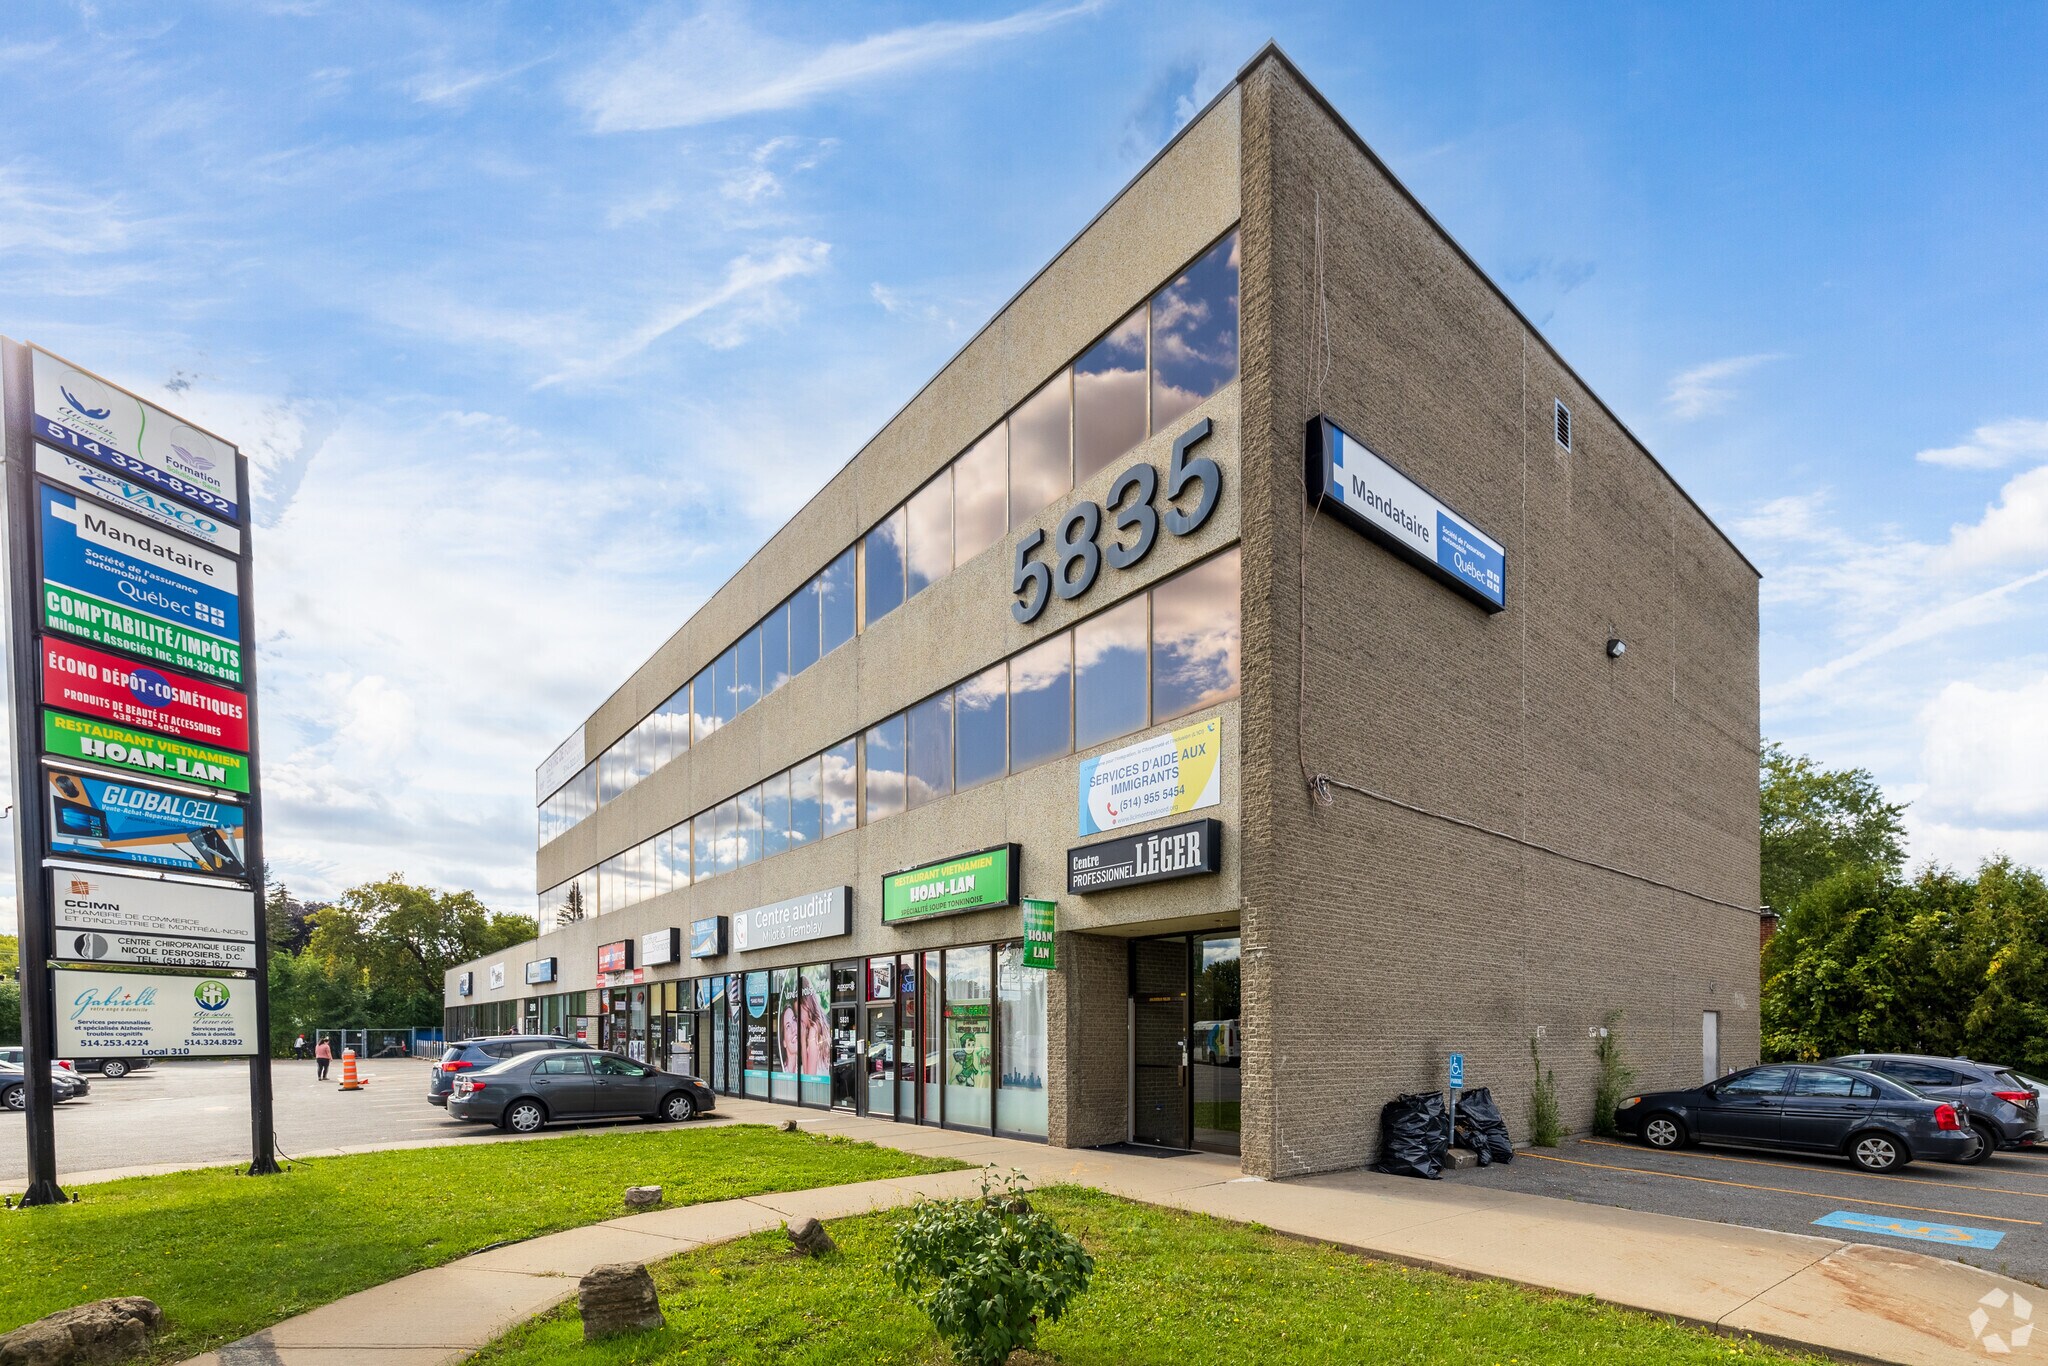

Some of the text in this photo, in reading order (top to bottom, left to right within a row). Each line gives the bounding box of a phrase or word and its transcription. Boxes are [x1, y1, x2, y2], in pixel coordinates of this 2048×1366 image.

[47, 421, 229, 513] 514 324-8292
[165, 456, 221, 488] Formation
[166, 465, 199, 485] Solutions
[121, 482, 218, 534] VASCO
[1010, 416, 1223, 625] 5835
[1352, 474, 1430, 543] Mandataire
[84, 513, 215, 577] Mandataire
[84, 548, 199, 595] Société de l'assurance
[85, 558, 148, 585] automobile
[1454, 552, 1486, 585] Québec
[118, 580, 191, 617] Québec
[46, 591, 240, 668] COMPTABILITÉ/IMPÔTS
[48, 615, 240, 682] Milone & Associés Inc. 514-326-8181
[48, 651, 97, 680] ÉCONO
[64, 688, 221, 737] PRODUITS DE BEAUTÉ ET ACCESSOIRES
[113, 711, 181, 735] 438-289-4054
[54, 717, 240, 768] RESTAURANT VIETNAMIEN
[80, 736, 227, 784] HOAN-LAN
[1089, 743, 1207, 788] SERVICES D'AIDE AUX
[1111, 767, 1180, 795] IMMIGRANTS
[1119, 784, 1186, 813] (514) 955 5454
[894, 856, 993, 888] RESTAURANT VIETNAMIEN
[1073, 831, 1202, 888] PROFESSIONNEL LÉGER
[1073, 854, 1100, 871] Centre
[909, 874, 976, 903] HOAN-LAN
[64, 900, 120, 911] CCIMN
[64, 908, 121, 919] CHAMBRE
[142, 915, 200, 925] COMMERCE
[756, 892, 833, 928] Centre auditif
[901, 895, 983, 917] SPÉCIALITÉ SOUPE TONKINOISE
[83, 917, 150, 928] D'INDUSTRIE
[168, 923, 249, 936] MONTRÉAL-NORD
[780, 927, 786, 939] &
[787, 920, 823, 938] Tremblay
[1028, 929, 1053, 942] HOAN
[118, 937, 246, 953] CENTRE CHIROPRATIQUE LEGER
[121, 947, 243, 960] NICOLE DESROSIERS, D.C.
[1033, 946, 1050, 959] LAN
[163, 956, 186, 966] (514)
[189, 958, 231, 967] 328-1677
[70, 986, 158, 1020] Gabrielle
[80, 1039, 149, 1047] 514.253.4224
[171, 1047, 190, 1055] 310
